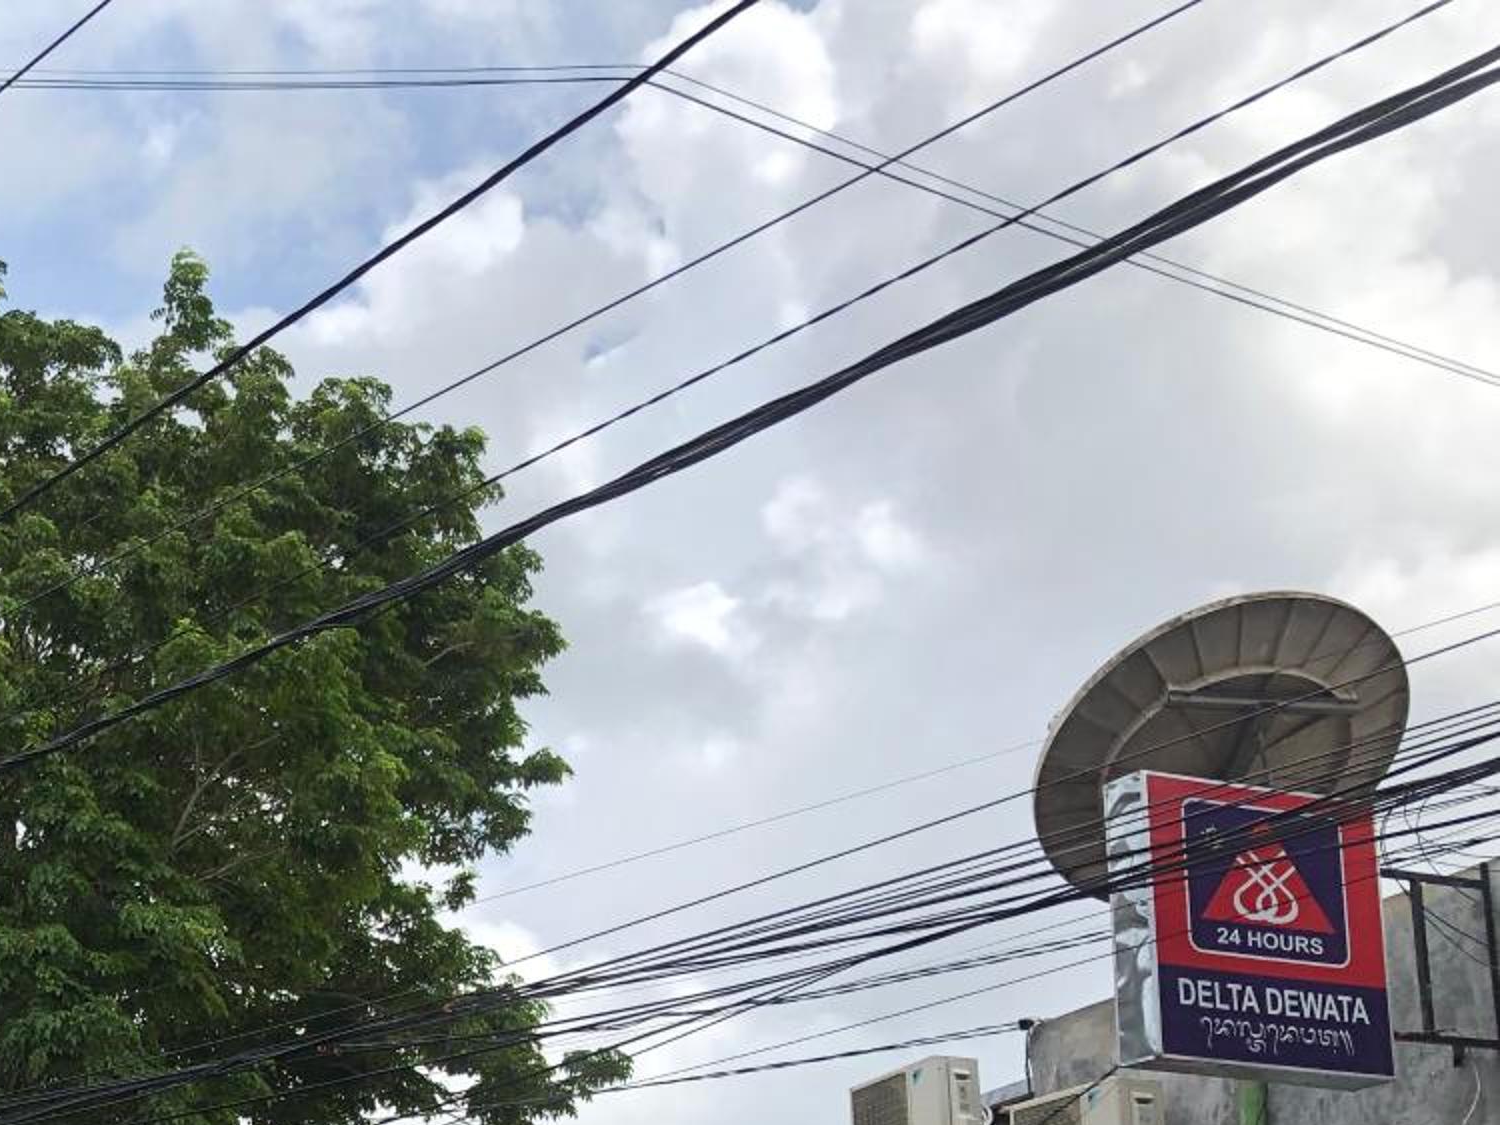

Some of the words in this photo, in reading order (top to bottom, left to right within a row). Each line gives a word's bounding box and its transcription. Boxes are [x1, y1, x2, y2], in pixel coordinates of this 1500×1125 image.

[1216, 927, 1241, 945] 24
[1247, 933, 1324, 955] HOURS
[1177, 977, 1260, 1014] DELTA
[1265, 987, 1370, 1025] DEWATA
